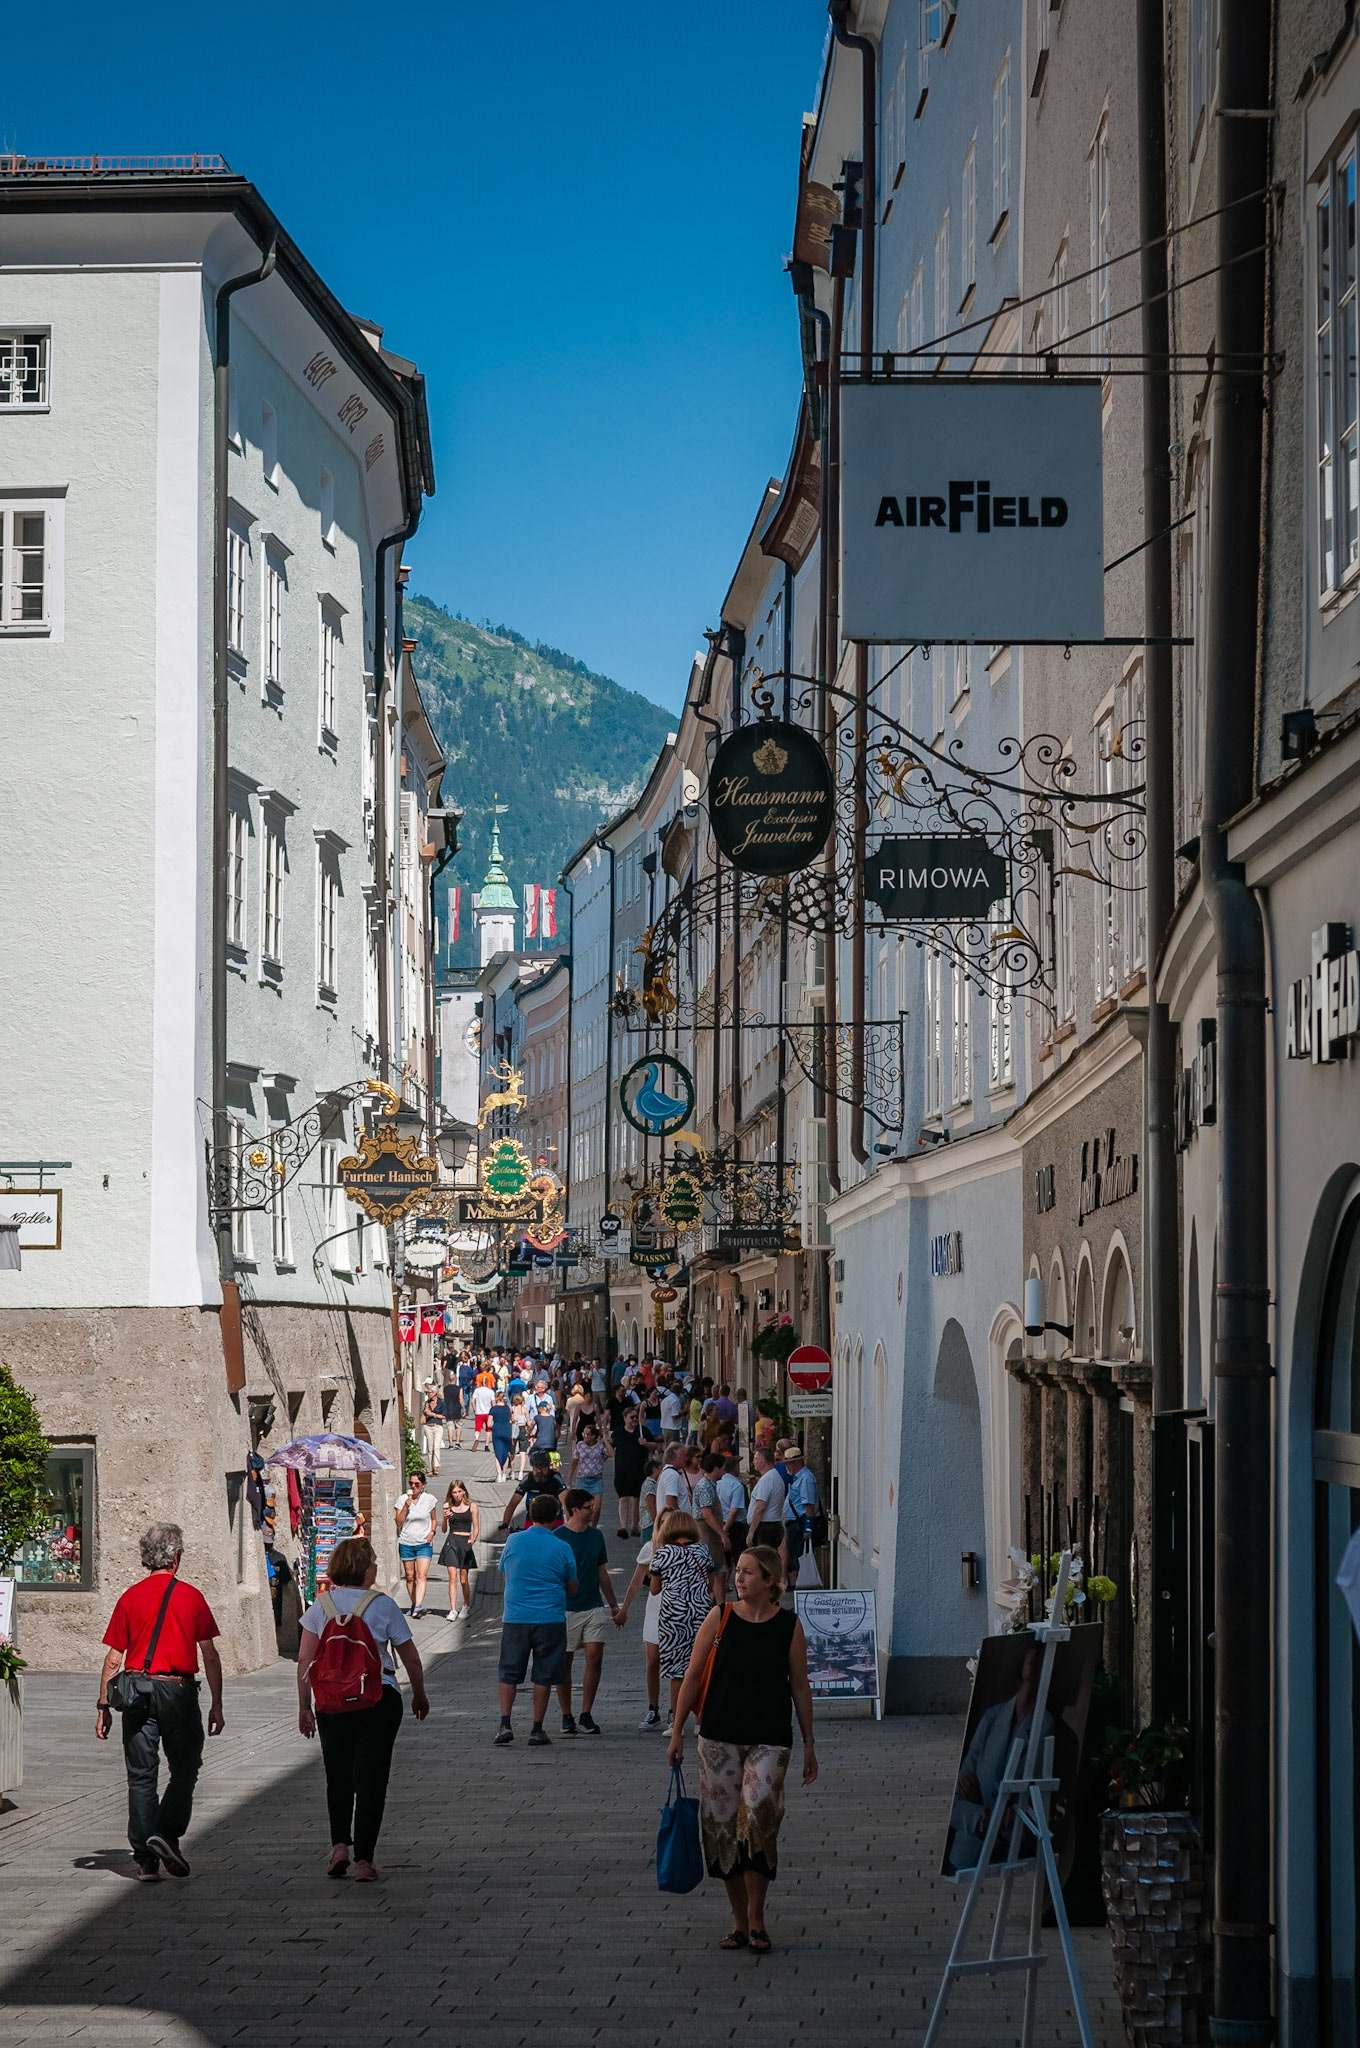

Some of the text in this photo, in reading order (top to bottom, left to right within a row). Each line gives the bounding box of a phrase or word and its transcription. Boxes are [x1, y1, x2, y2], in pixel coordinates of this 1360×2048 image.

[303, 350, 339, 392] 1407
[337, 393, 369, 434] 1972
[715, 776, 827, 807] Haasmann
[763, 807, 818, 826] Exclusiv
[732, 819, 814, 856] Juwelen
[879, 867, 990, 890] RIMOWA
[497, 1152, 515, 1160] Hotel
[492, 1166, 521, 1174] Goldener
[342, 1170, 433, 1183] Furtner Hanisch
[496, 1179, 518, 1188] Hirsch
[9, 1211, 53, 1224] Nadler
[722, 1237, 781, 1246] SPIRITUOSEN
[633, 1251, 673, 1263] STASSNY
[813, 1597, 857, 1608] Gastgarten
[808, 1606, 862, 1616] OUTDOOR RESTAURANT
